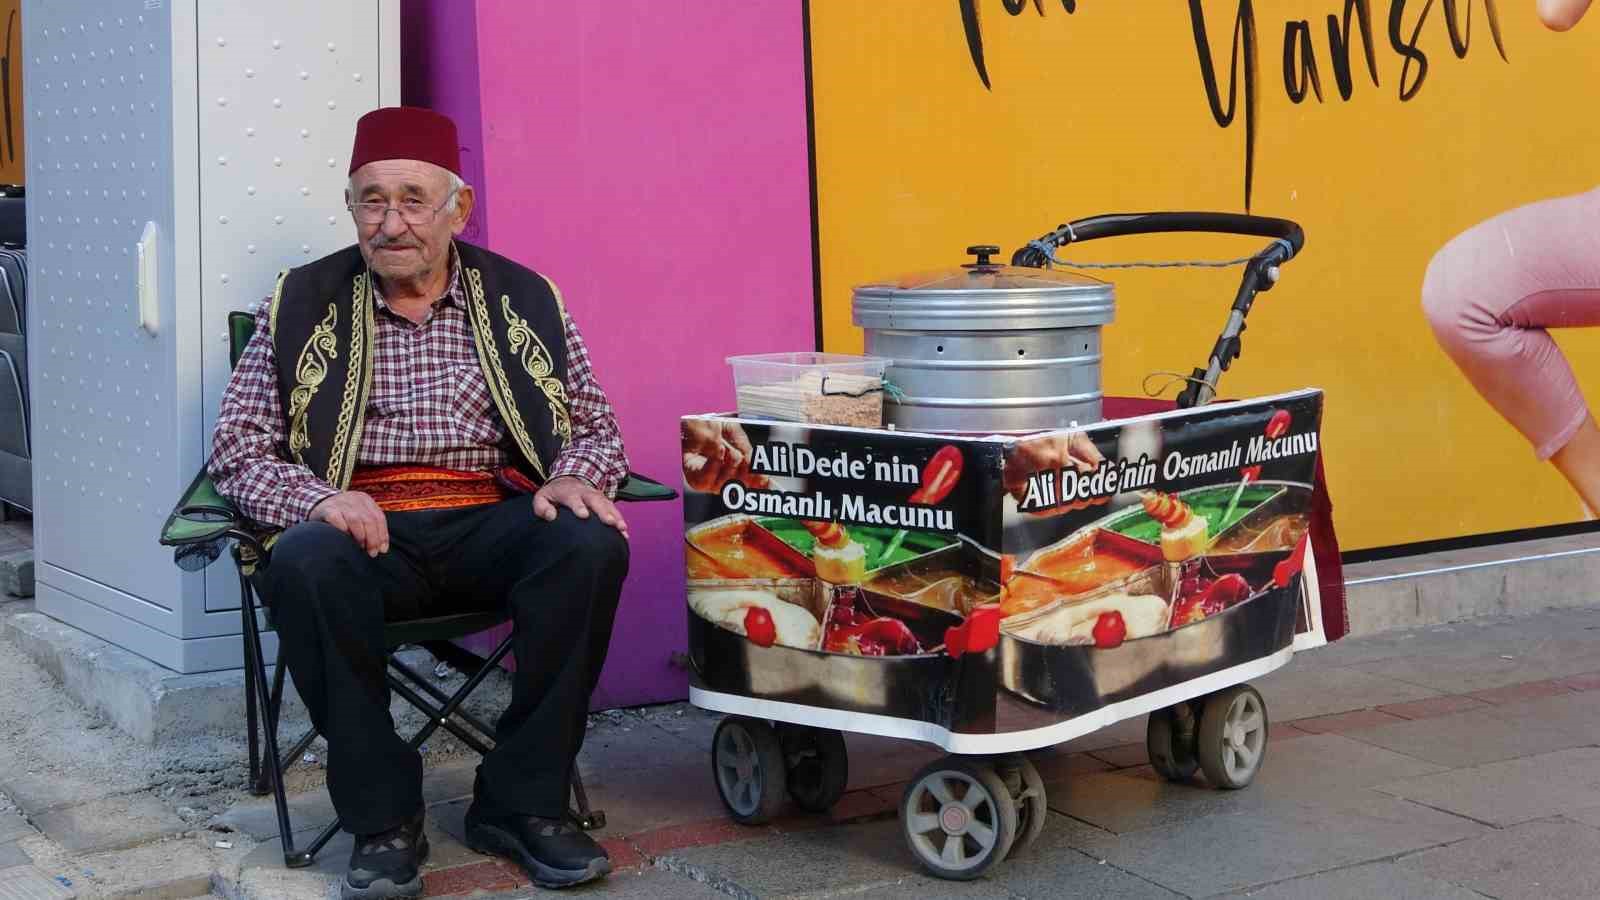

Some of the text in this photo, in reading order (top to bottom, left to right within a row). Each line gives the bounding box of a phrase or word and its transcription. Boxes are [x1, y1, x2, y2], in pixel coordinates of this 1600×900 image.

[752, 445, 920, 484] Ali Dede'nin
[1021, 431, 1318, 509] Ali Dede'nin Osmanlı Macunu
[722, 483, 954, 530] Osmanlı Macunu
